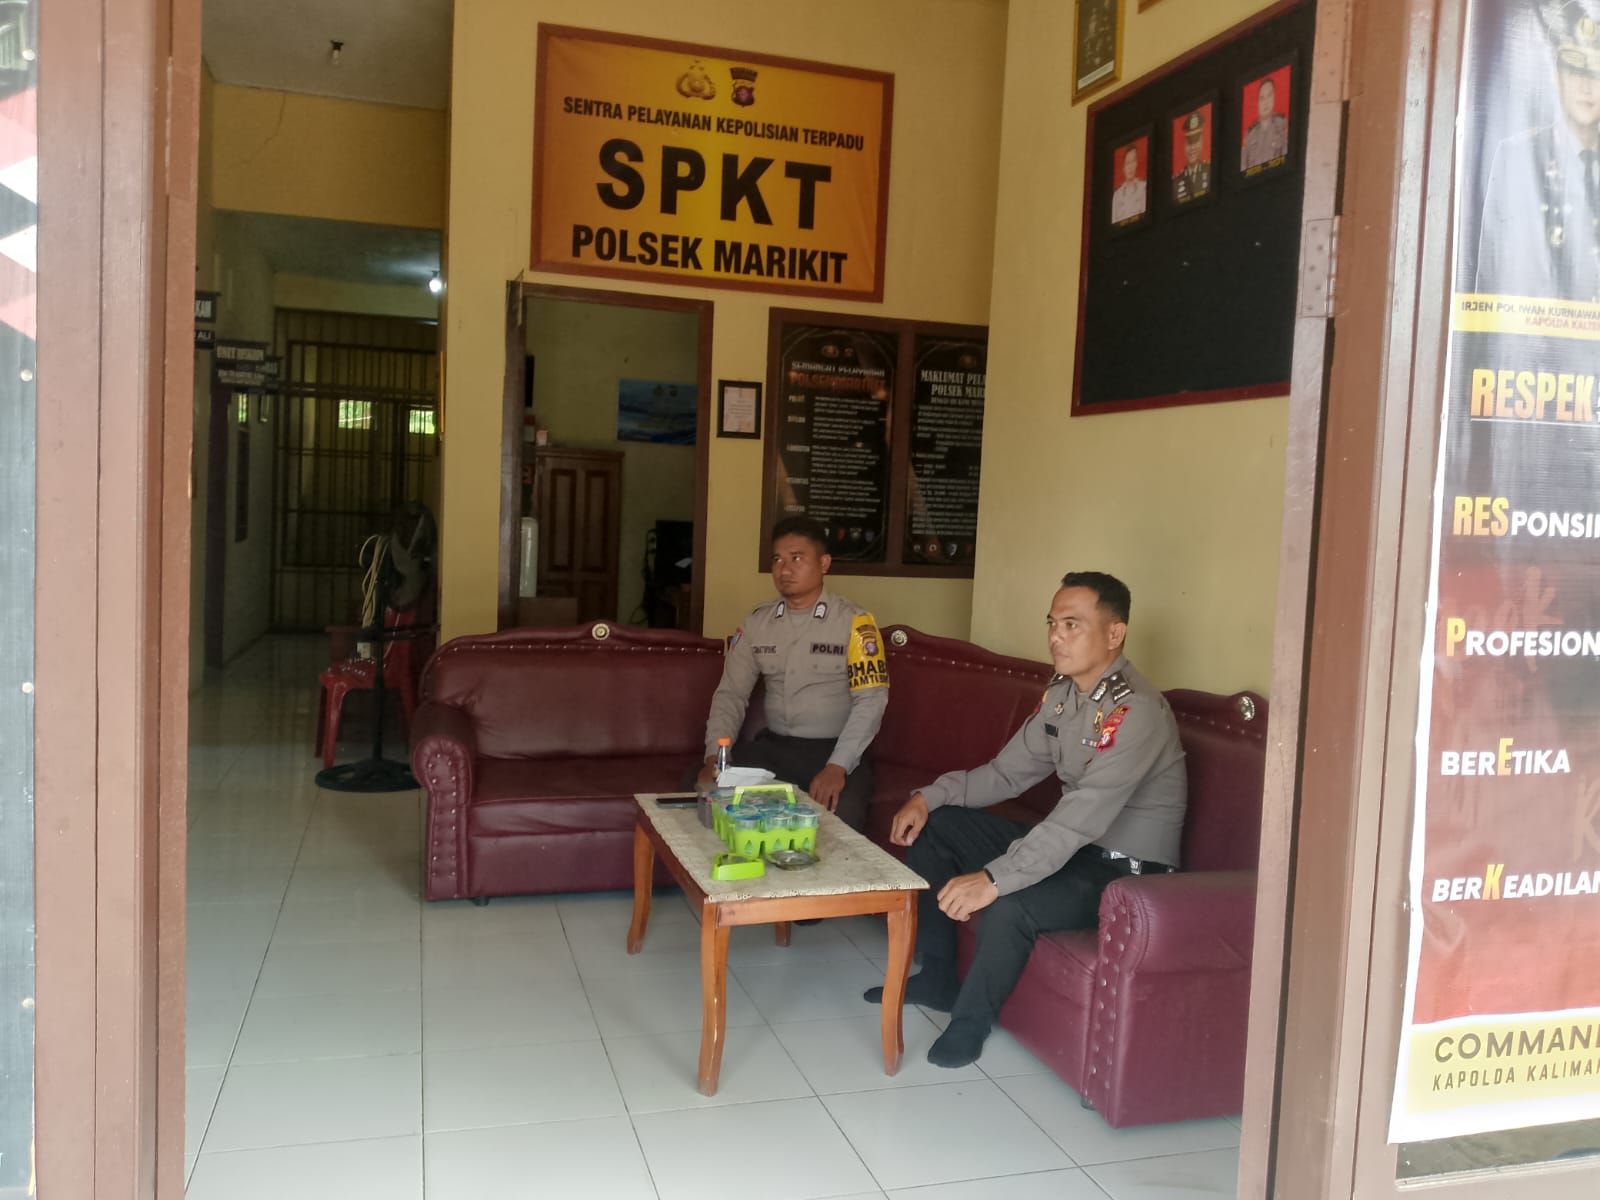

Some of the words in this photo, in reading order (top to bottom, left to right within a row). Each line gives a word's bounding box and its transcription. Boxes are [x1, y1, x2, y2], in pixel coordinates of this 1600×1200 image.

[563, 96, 623, 120] SENTRA
[627, 105, 711, 132] PELAYANAN
[716, 116, 799, 143] KEPOLISIAN
[802, 128, 864, 152] TERPADU
[596, 138, 832, 231] SPKT
[571, 223, 703, 271] POLSEK
[713, 239, 848, 284] MARIKIT
[931, 383, 963, 398] POLSEK
[1470, 368, 1595, 422] RESPEK
[811, 643, 844, 656] POLRI
[1440, 738, 1570, 777] BERETIKA
[1434, 1023, 1600, 1063] COMMAN
[1432, 1066, 1515, 1092] KAPOLDA
